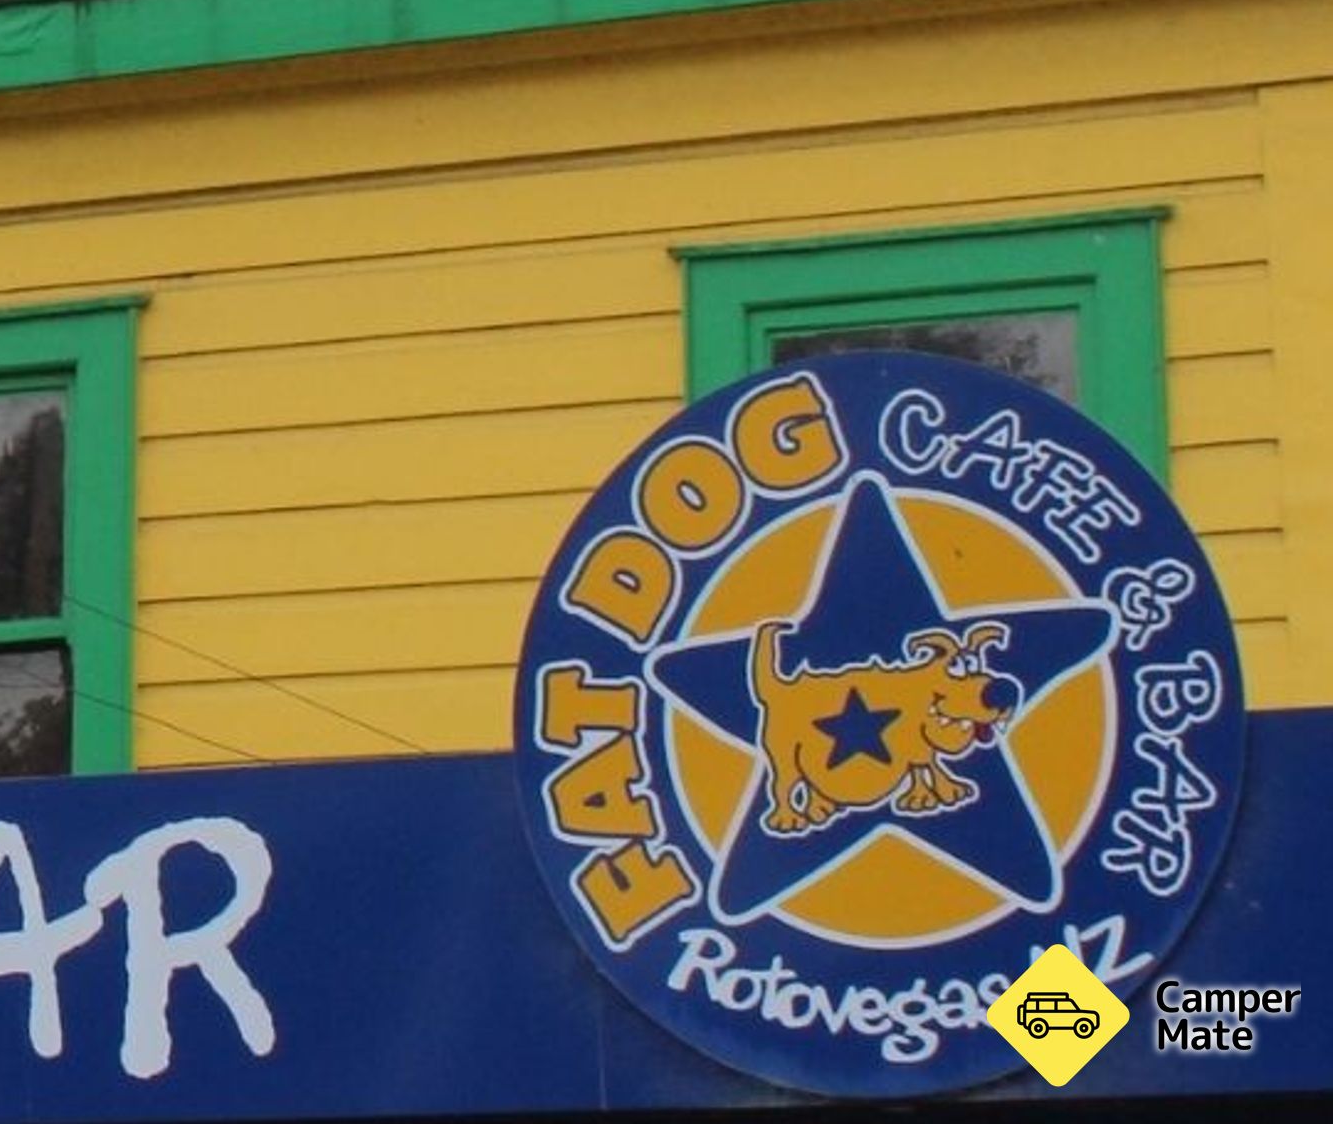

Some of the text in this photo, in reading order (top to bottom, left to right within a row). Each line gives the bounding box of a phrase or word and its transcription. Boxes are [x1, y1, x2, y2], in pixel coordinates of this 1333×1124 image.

[535, 372, 1222, 952] FAT DOG CAFE & BAR
